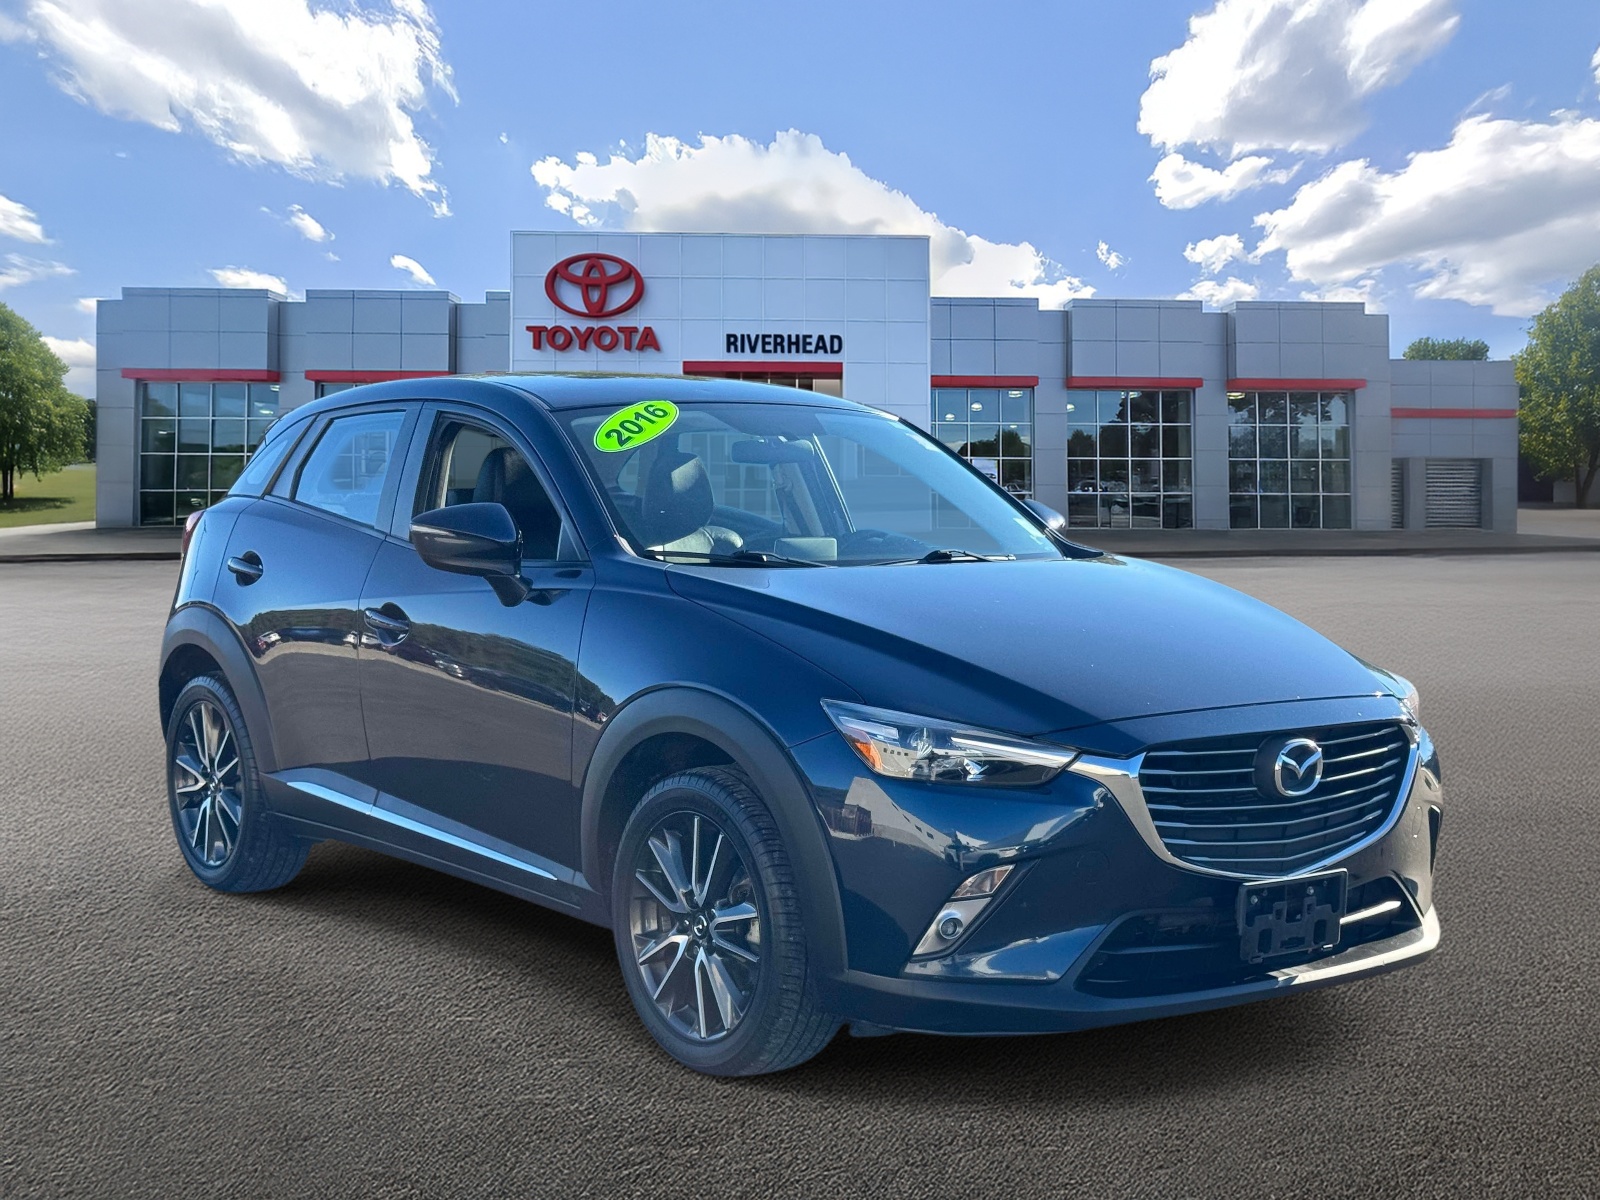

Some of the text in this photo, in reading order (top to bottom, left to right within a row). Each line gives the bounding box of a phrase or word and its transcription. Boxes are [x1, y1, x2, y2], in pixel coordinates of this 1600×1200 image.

[526, 326, 660, 352] TOYOTA
[726, 333, 843, 354] RIVERHEAD
[605, 404, 669, 447] 2016
